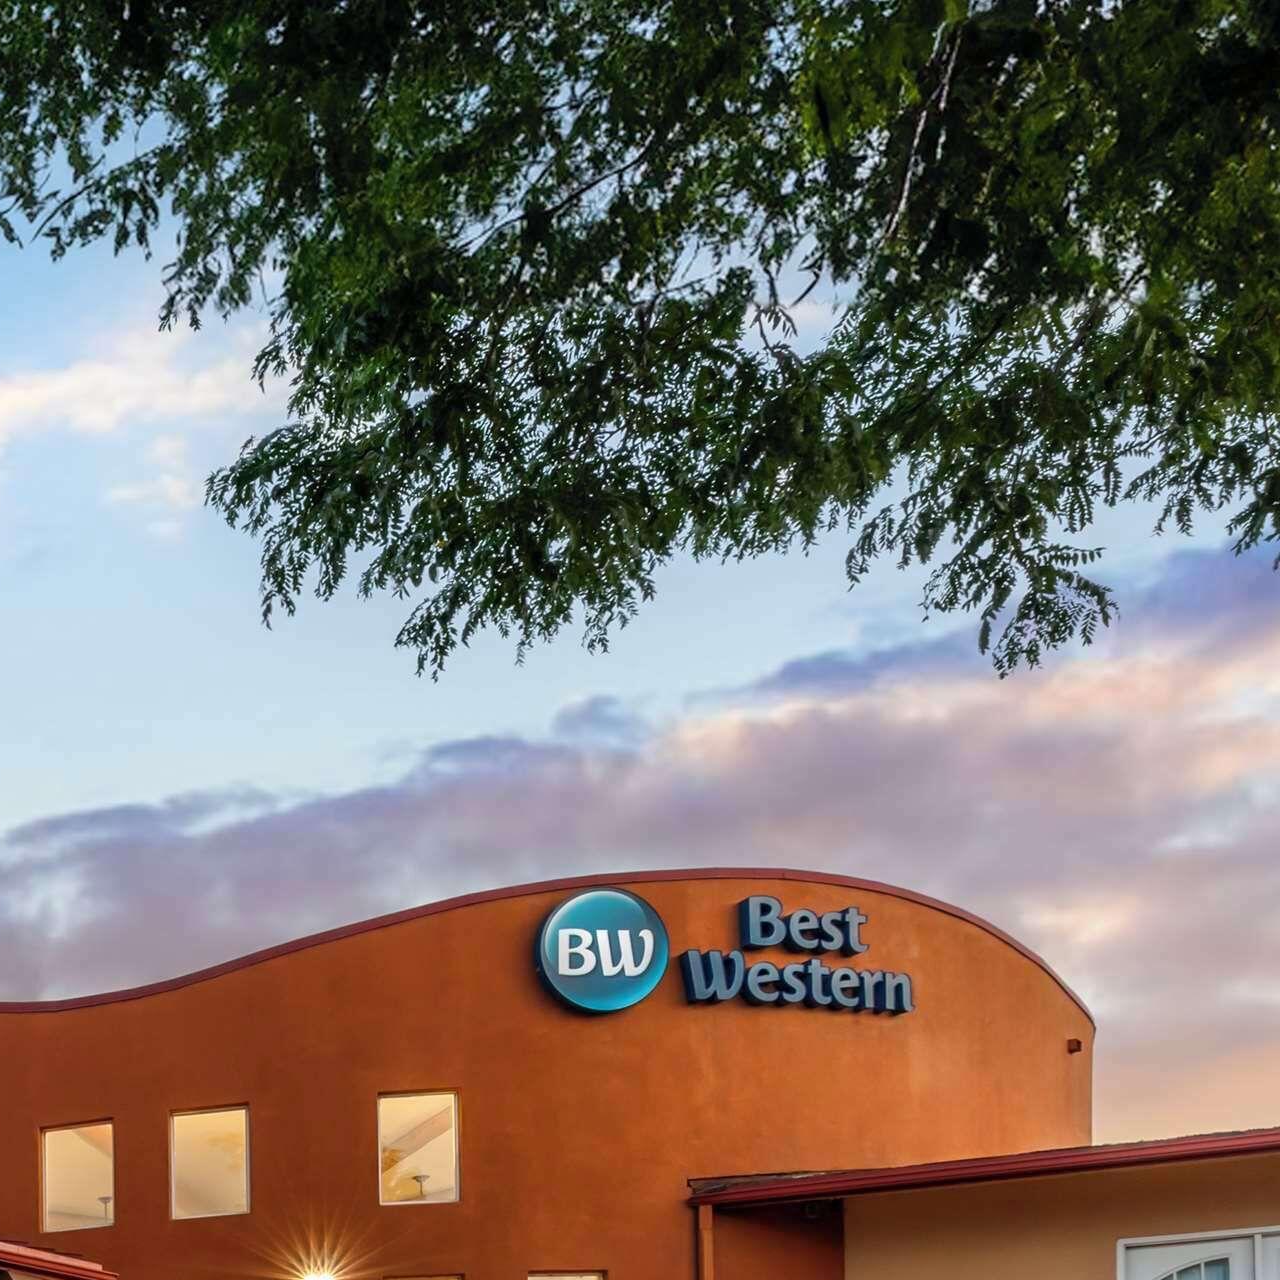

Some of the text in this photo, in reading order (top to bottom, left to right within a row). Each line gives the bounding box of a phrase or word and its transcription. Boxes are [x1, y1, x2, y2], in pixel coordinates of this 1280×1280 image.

[557, 928, 655, 978] BW
[742, 895, 869, 954] Best
[682, 949, 914, 1014] Western
